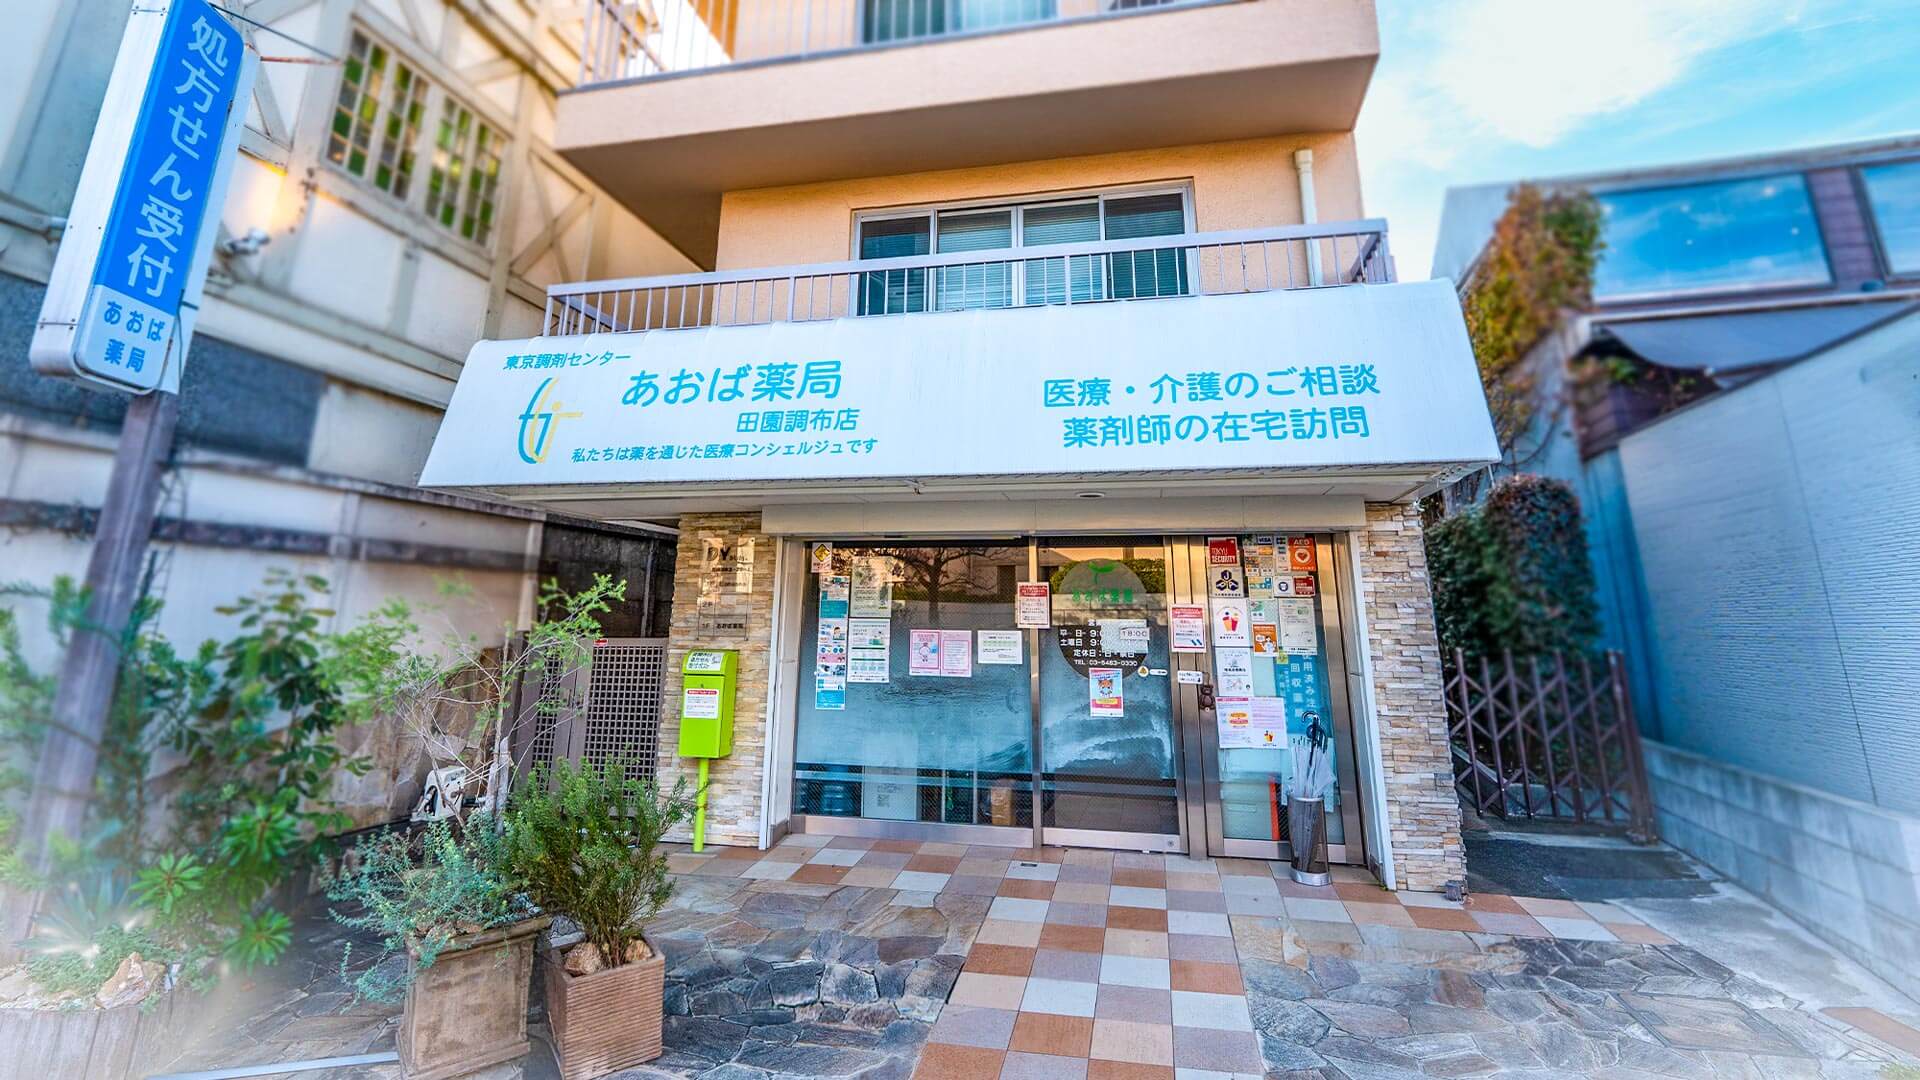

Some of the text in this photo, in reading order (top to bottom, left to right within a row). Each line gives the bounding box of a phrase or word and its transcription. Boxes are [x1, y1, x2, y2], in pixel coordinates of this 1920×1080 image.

[127, 15, 229, 298] 処方せん受付
[104, 301, 166, 341] あおば
[104, 338, 146, 374] 薬局
[503, 351, 632, 371] 東京調剤センター
[621, 360, 843, 408] あおば薬局
[1043, 363, 1382, 408] 医療・介護のご相談
[736, 408, 861, 433] 田園調布店
[1063, 405, 1371, 449] 薬剤師の在宅訪問
[571, 438, 878, 464] 私たちは薬を通じた医療コンシェルジュです
[1211, 555, 1236, 563] SECURITY
